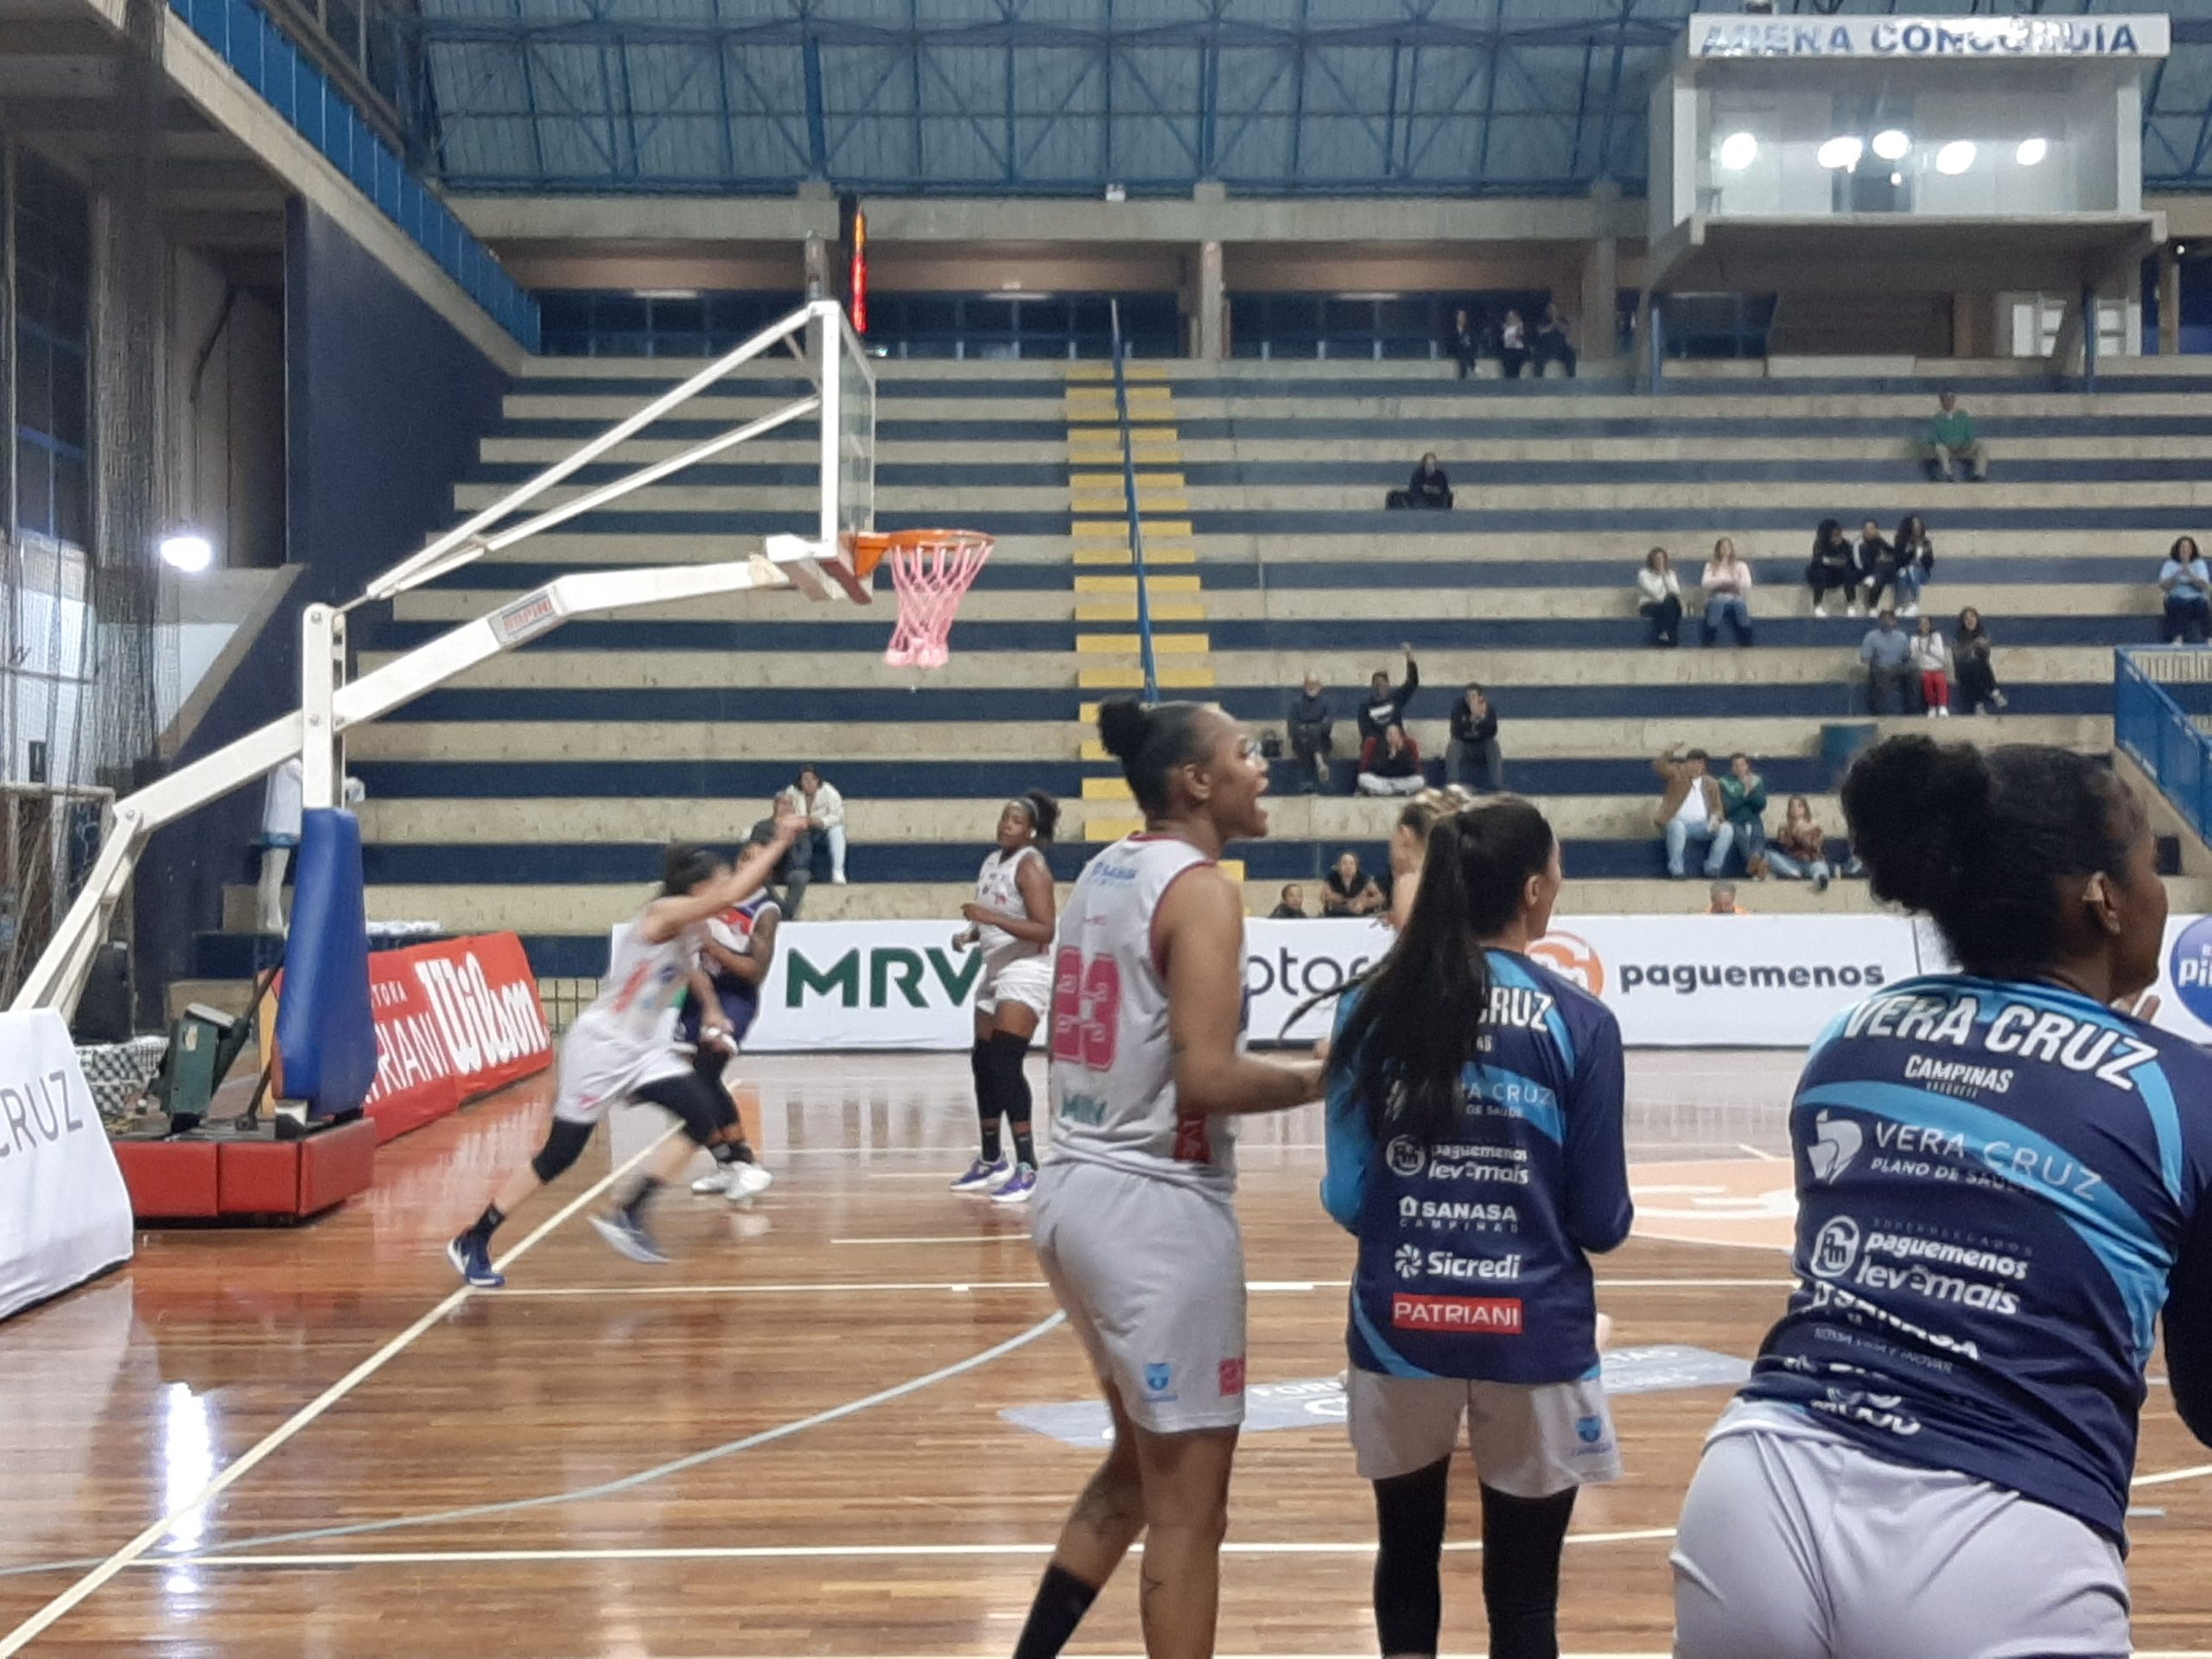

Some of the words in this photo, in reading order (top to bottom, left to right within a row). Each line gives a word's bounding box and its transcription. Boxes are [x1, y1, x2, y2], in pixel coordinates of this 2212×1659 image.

[786, 947, 983, 1009] MRV
[1618, 963, 1885, 994] paguemenos
[1843, 995, 1979, 1045] VERA
[1984, 1004, 2158, 1091] CRUZ
[1904, 1054, 2015, 1094] CAMPINAS
[0, 1069, 84, 1157] RUZ
[1870, 1156, 1931, 1177] PLANO
[1935, 1166, 1960, 1182] DE
[1875, 1121, 1966, 1159] VERA
[1983, 1140, 2102, 1202] CRUZ
[1421, 1201, 1517, 1222] SANASA
[1427, 1250, 1522, 1279] Sicredi
[1865, 1230, 2029, 1280] paguemenos
[1394, 1301, 1518, 1327] PATRIANI
